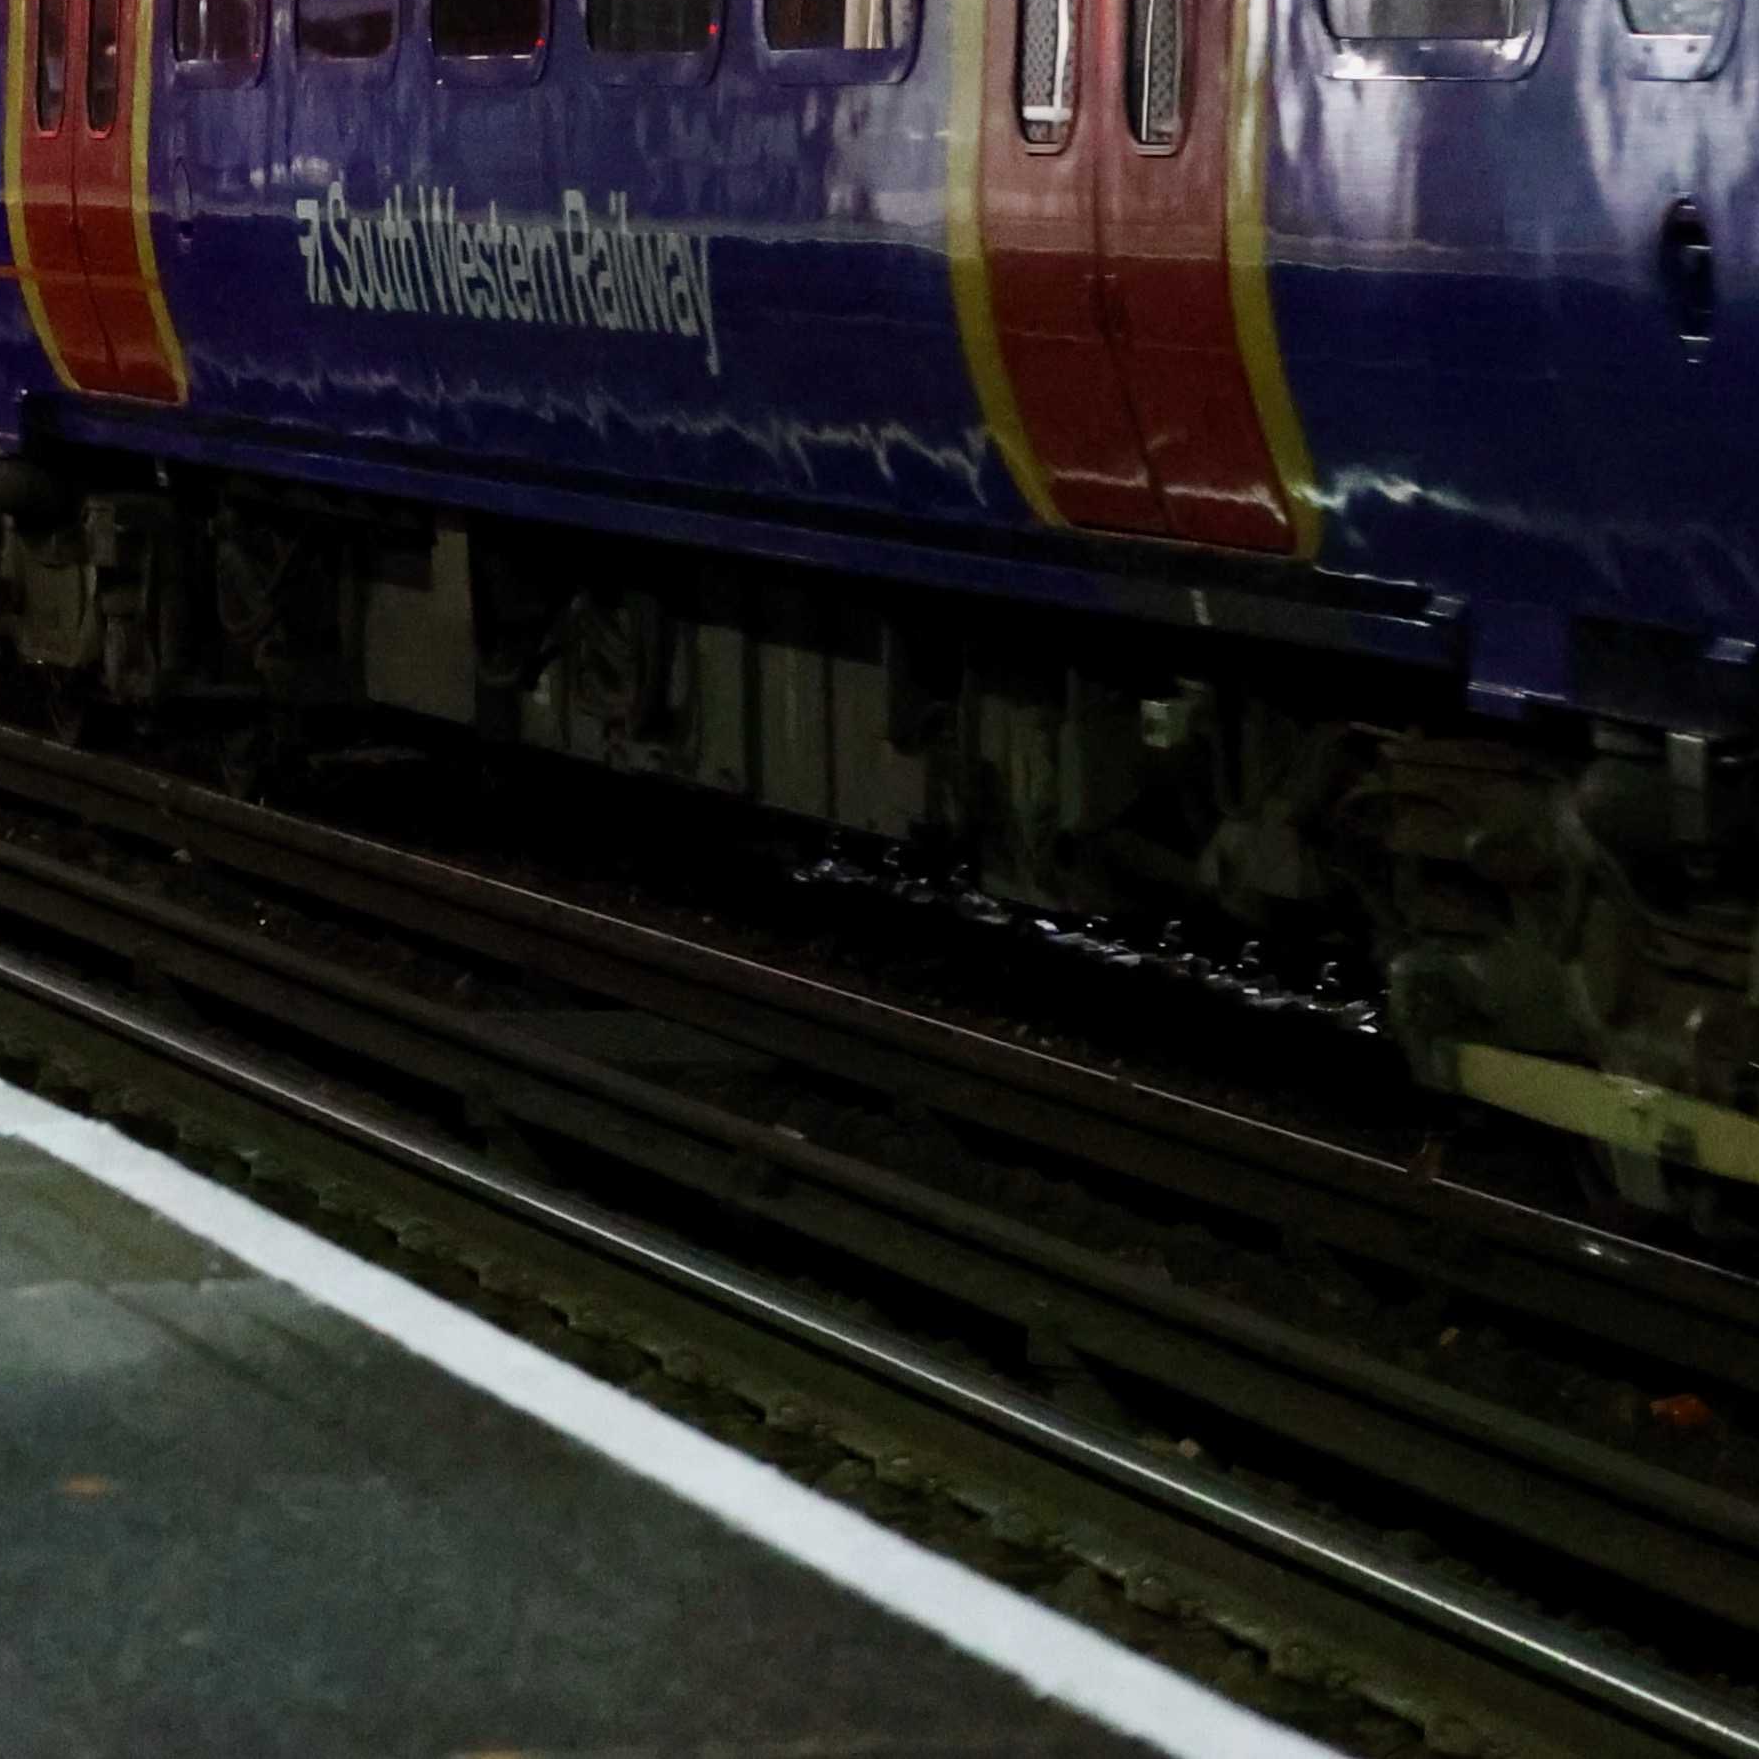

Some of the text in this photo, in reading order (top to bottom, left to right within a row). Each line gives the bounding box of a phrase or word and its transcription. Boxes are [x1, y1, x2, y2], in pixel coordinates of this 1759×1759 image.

[328, 180, 721, 377] South Western Railway
